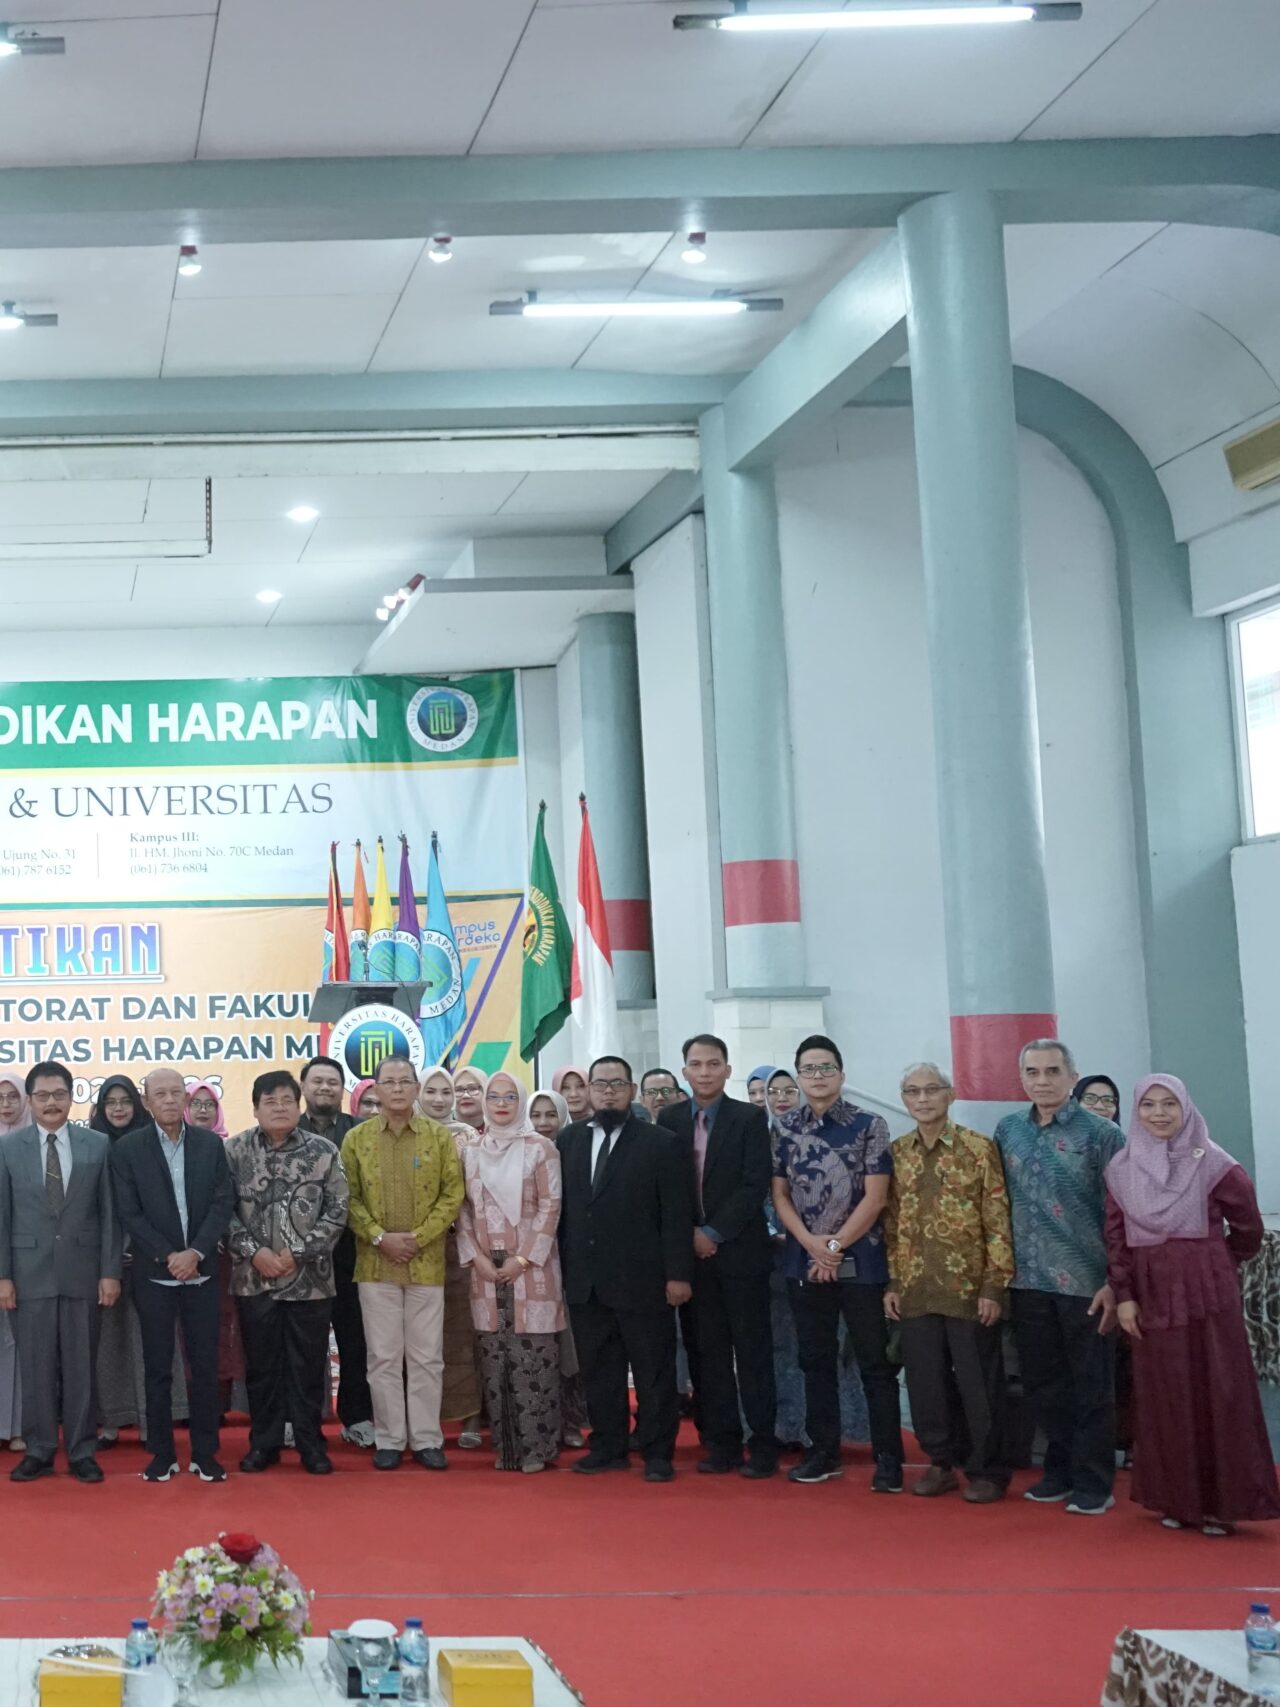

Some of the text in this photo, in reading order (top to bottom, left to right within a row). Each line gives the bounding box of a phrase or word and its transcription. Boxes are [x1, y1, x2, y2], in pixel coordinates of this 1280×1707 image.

[149, 700, 378, 742] HARAPAN
[9, 788, 38, 818] &
[51, 783, 334, 817] UNIVERSITAS
[130, 832, 178, 845] Kampus
[206, 847, 226, 857] No.
[229, 846, 253, 857] 70C
[254, 845, 293, 856] Medan
[3, 850, 37, 862] Ujung
[454, 921, 496, 936] mpus
[458, 933, 500, 945] rdeka
[122, 995, 196, 1020] DAN
[429, 978, 461, 1015] MEDAN
[103, 1034, 274, 1061] HARAPAN
[334, 1010, 387, 1058] NIVERSITAS
[391, 1014, 420, 1066] HARAPA
